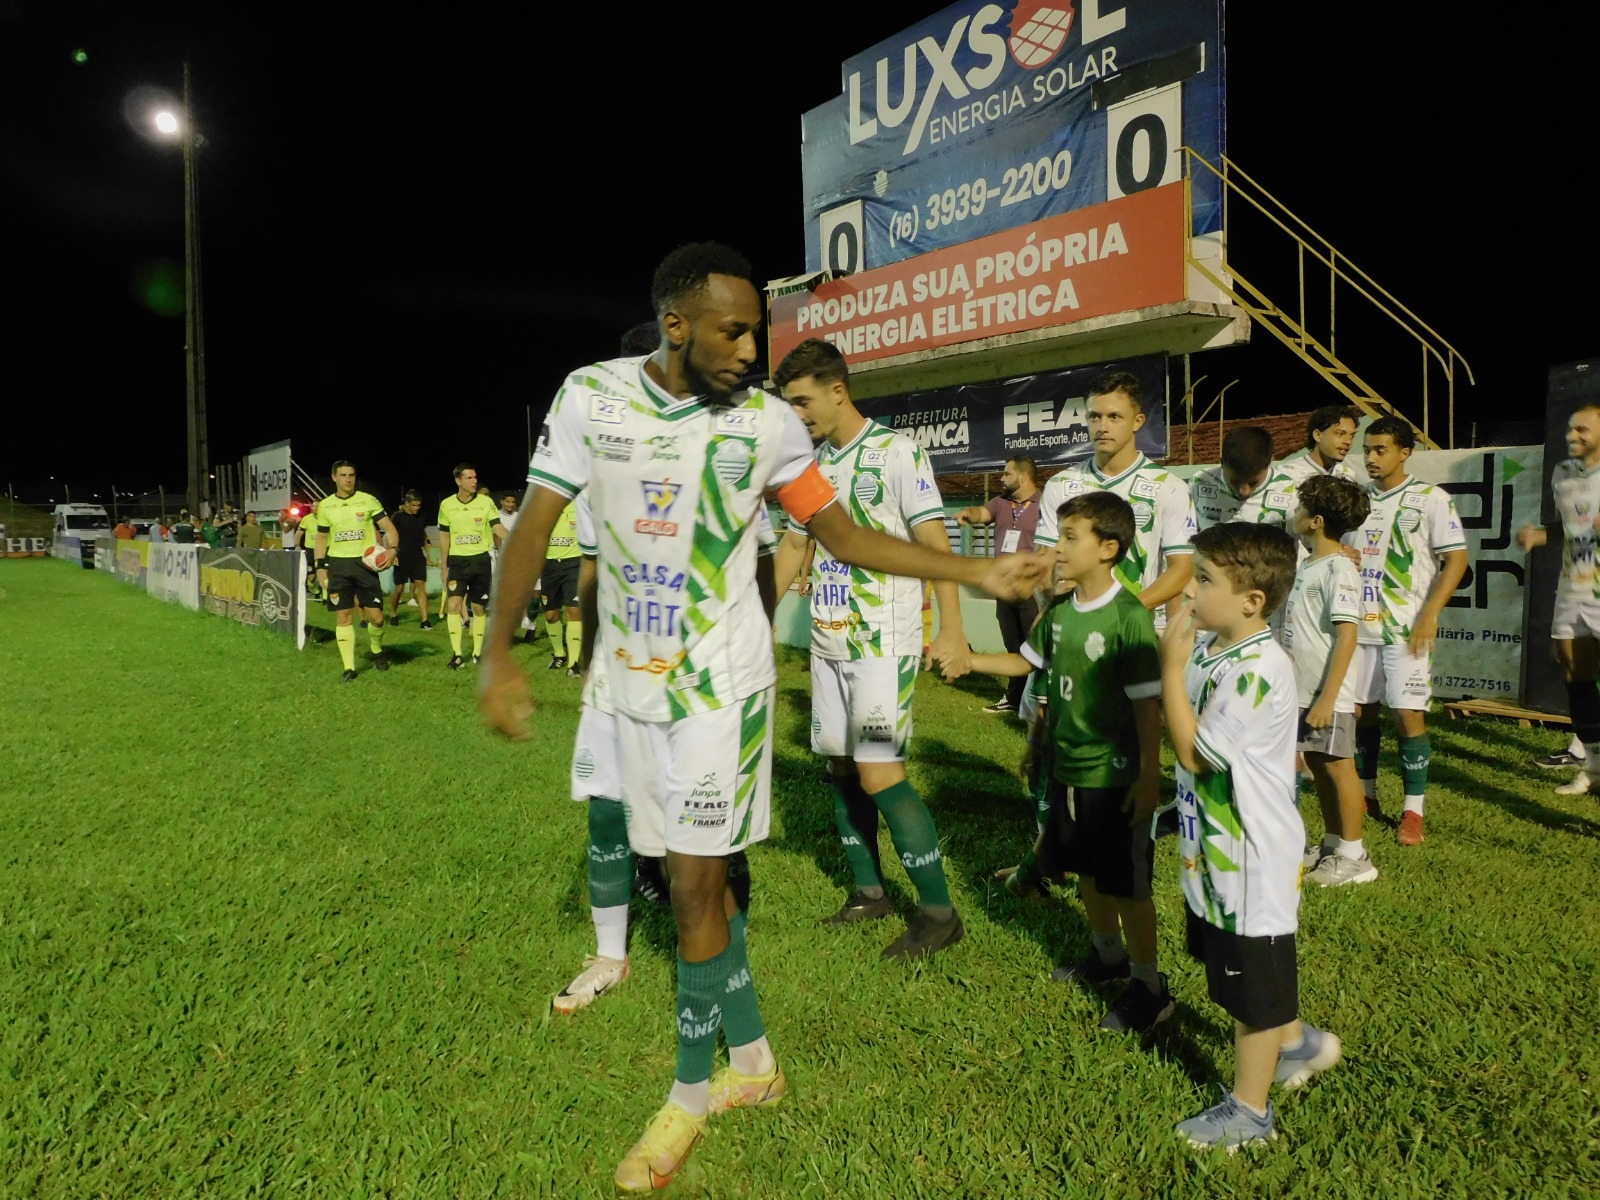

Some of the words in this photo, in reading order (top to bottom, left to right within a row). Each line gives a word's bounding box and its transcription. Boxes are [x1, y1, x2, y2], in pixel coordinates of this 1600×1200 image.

[930, 85, 1025, 144] ENERGIA
[1033, 46, 1118, 103] SOLAR
[1115, 113, 1168, 196] 0
[889, 204, 919, 248] (16)
[925, 150, 1072, 231] 3939-2200
[797, 282, 908, 333] PRODUZA
[912, 263, 971, 304] SUA
[976, 222, 1129, 287] PRÓPRIA
[932, 278, 1079, 337] ELÉTRICA
[894, 406, 968, 427] PREFEITURA
[1004, 396, 1087, 435] FEA
[598, 434, 635, 445] FEAC
[1004, 436, 1038, 450] Fundação
[1040, 433, 1071, 447] Esporte,
[1072, 431, 1088, 443] Arte
[868, 452, 880, 460] Q2
[258, 468, 287, 492] HEADER
[1141, 484, 1153, 492] Q2
[623, 563, 684, 592] CASA
[816, 584, 849, 606] FIAT
[627, 597, 681, 636] FIAT
[1060, 675, 1073, 701] 12
[1446, 676, 1511, 691] 3722-7516
[684, 800, 728, 809] FEAC
[690, 788, 721, 799] junpe
[693, 818, 726, 827] FRANCA
